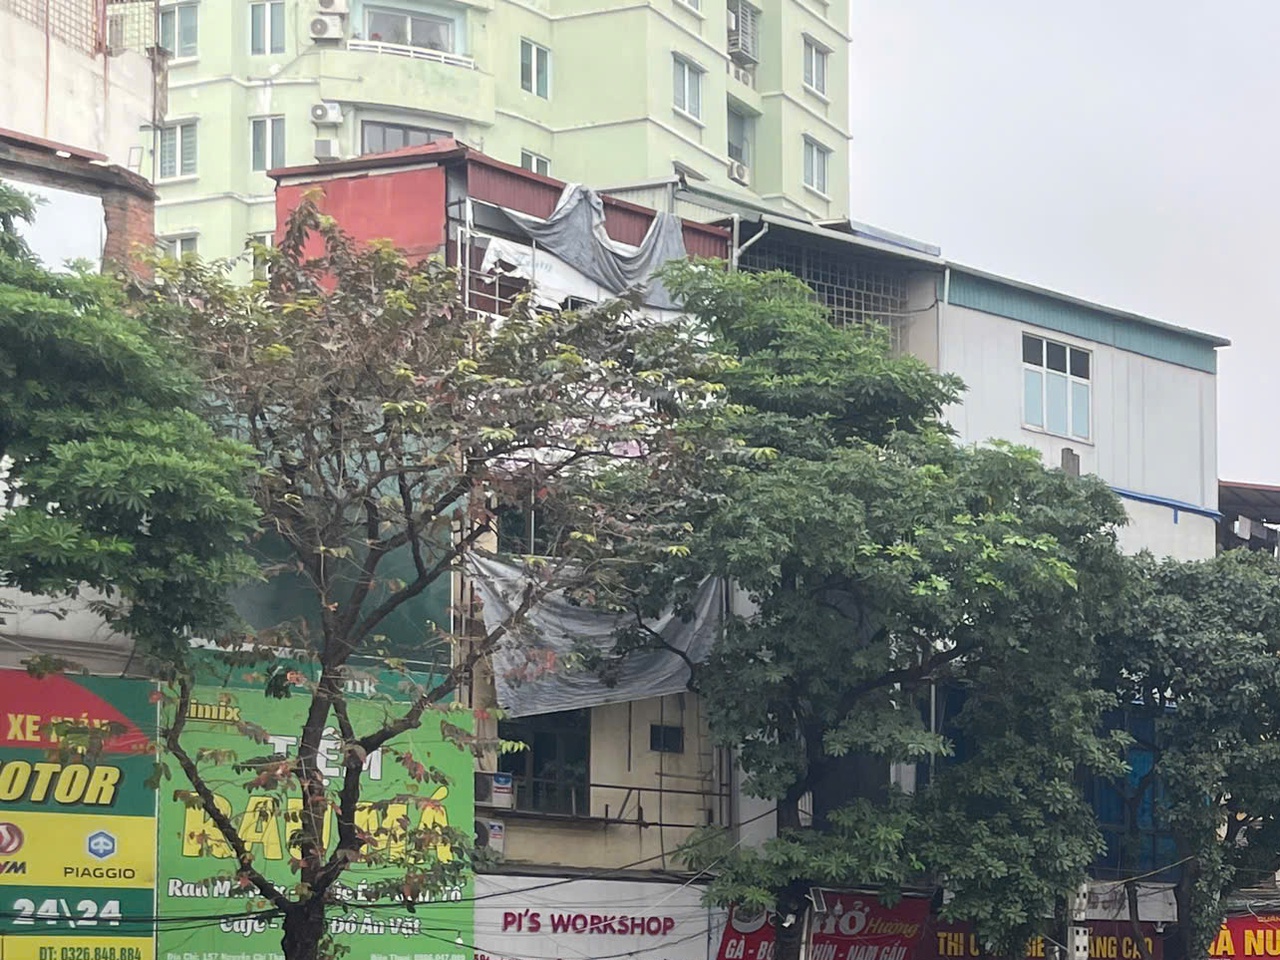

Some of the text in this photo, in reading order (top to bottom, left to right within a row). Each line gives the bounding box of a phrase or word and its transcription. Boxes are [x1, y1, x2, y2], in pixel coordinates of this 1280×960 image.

[185, 701, 241, 722] imix
[7, 713, 41, 742] XE
[0, 760, 121, 805] OTOR
[63, 866, 136, 879] PIAGGIO
[360, 912, 385, 934] Ăn
[502, 908, 675, 936] PI'S WORKSHOP
[725, 935, 746, 960] GÀ
[936, 931, 965, 957] THI
[1088, 926, 1117, 958] ẢNG
[1209, 921, 1236, 956] À
